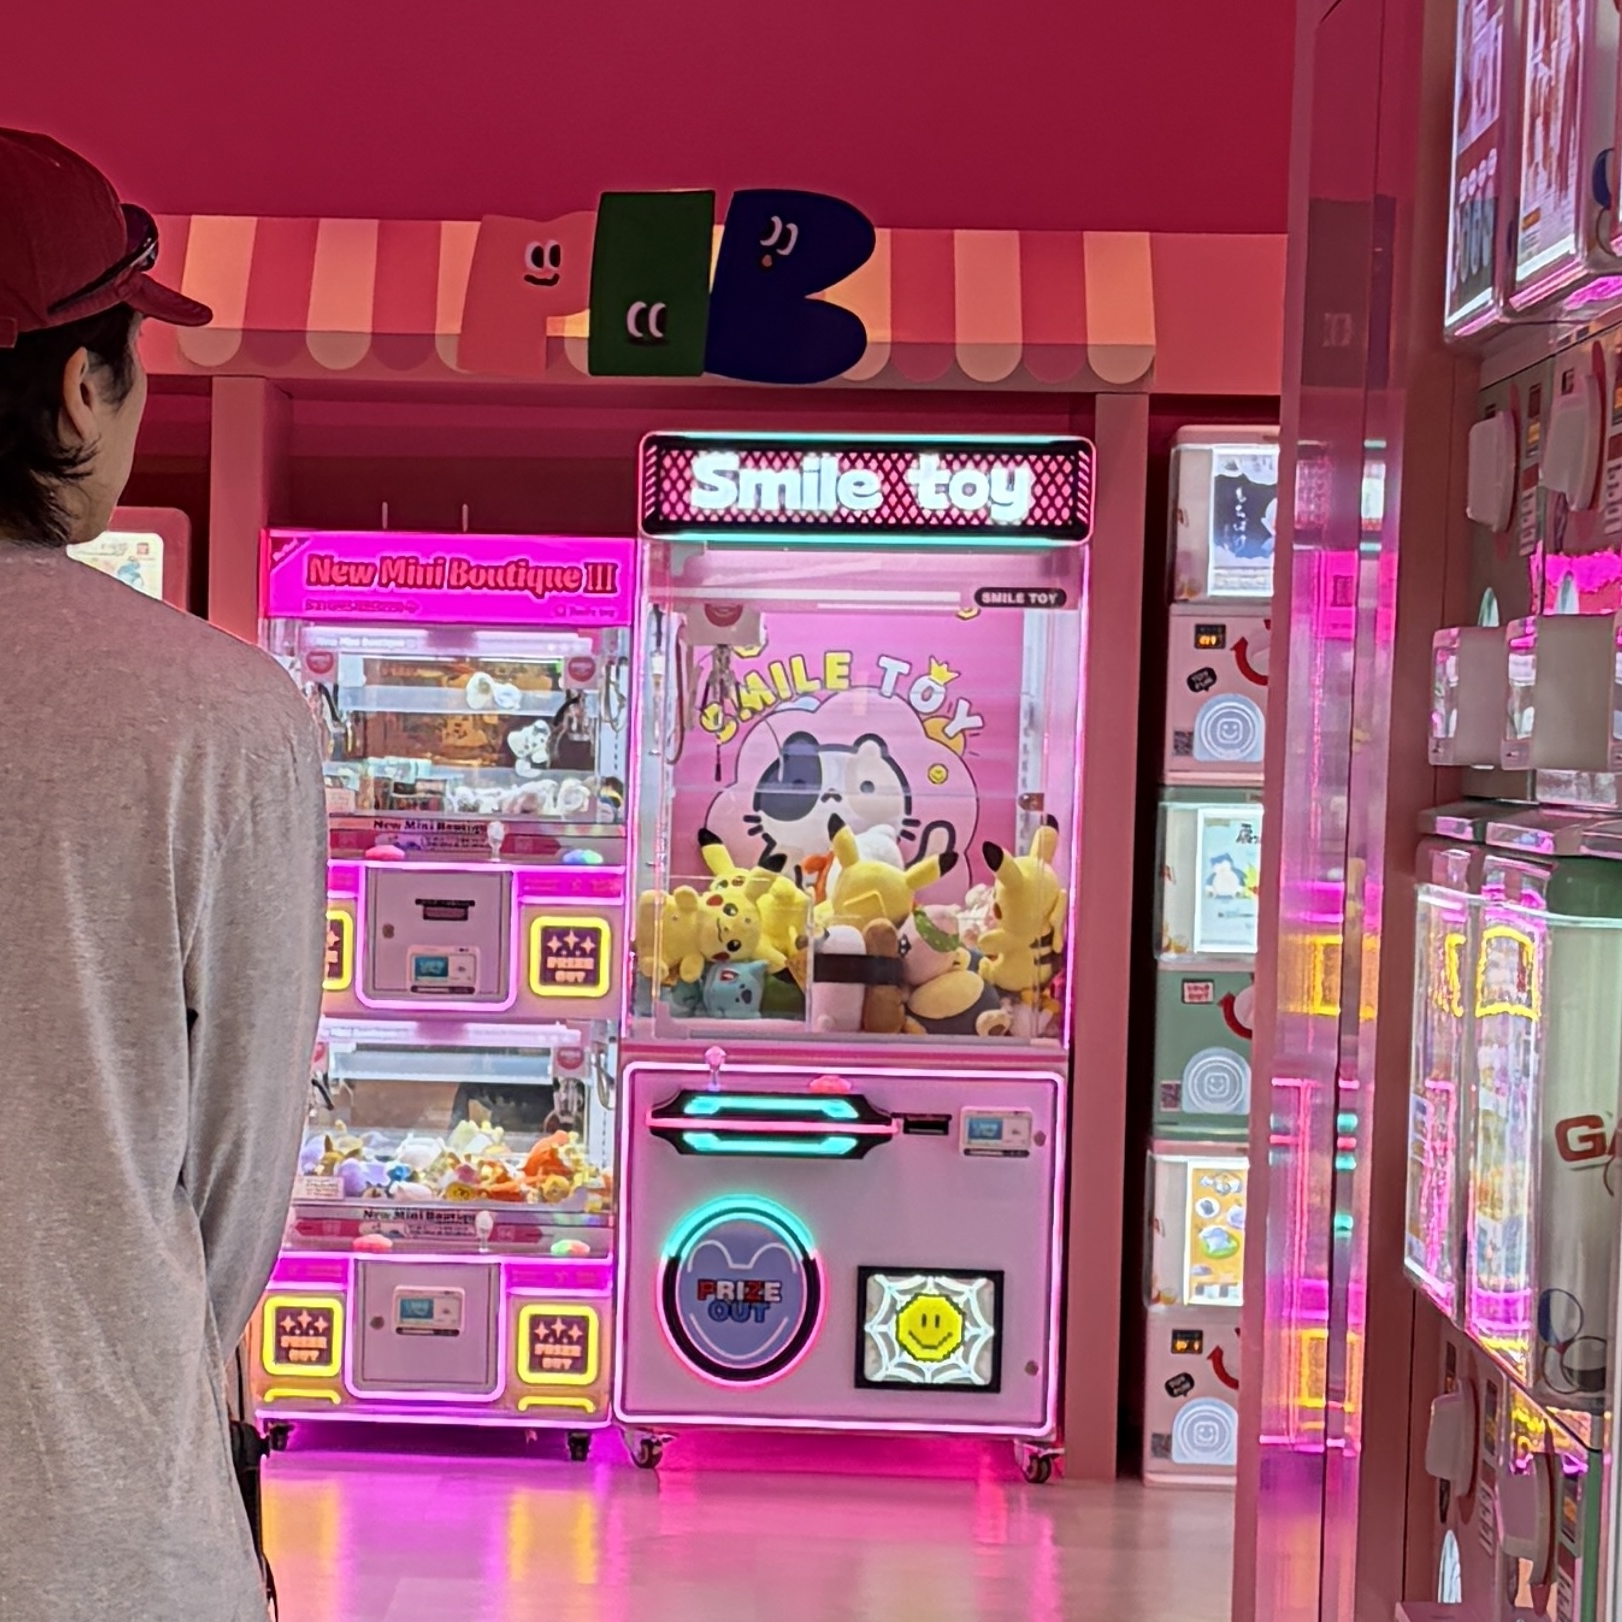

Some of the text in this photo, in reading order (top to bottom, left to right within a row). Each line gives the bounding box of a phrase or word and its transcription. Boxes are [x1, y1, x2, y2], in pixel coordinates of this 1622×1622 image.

[690, 450, 1034, 523] Smile toy
[307, 554, 619, 600] New Mini Boutique III
[981, 591, 1058, 604] SMILE TOY
[699, 650, 985, 744] SMILE TOY
[404, 819, 433, 831] Mini
[696, 1278, 783, 1303] PRIZE
[707, 1300, 770, 1323] OUT
